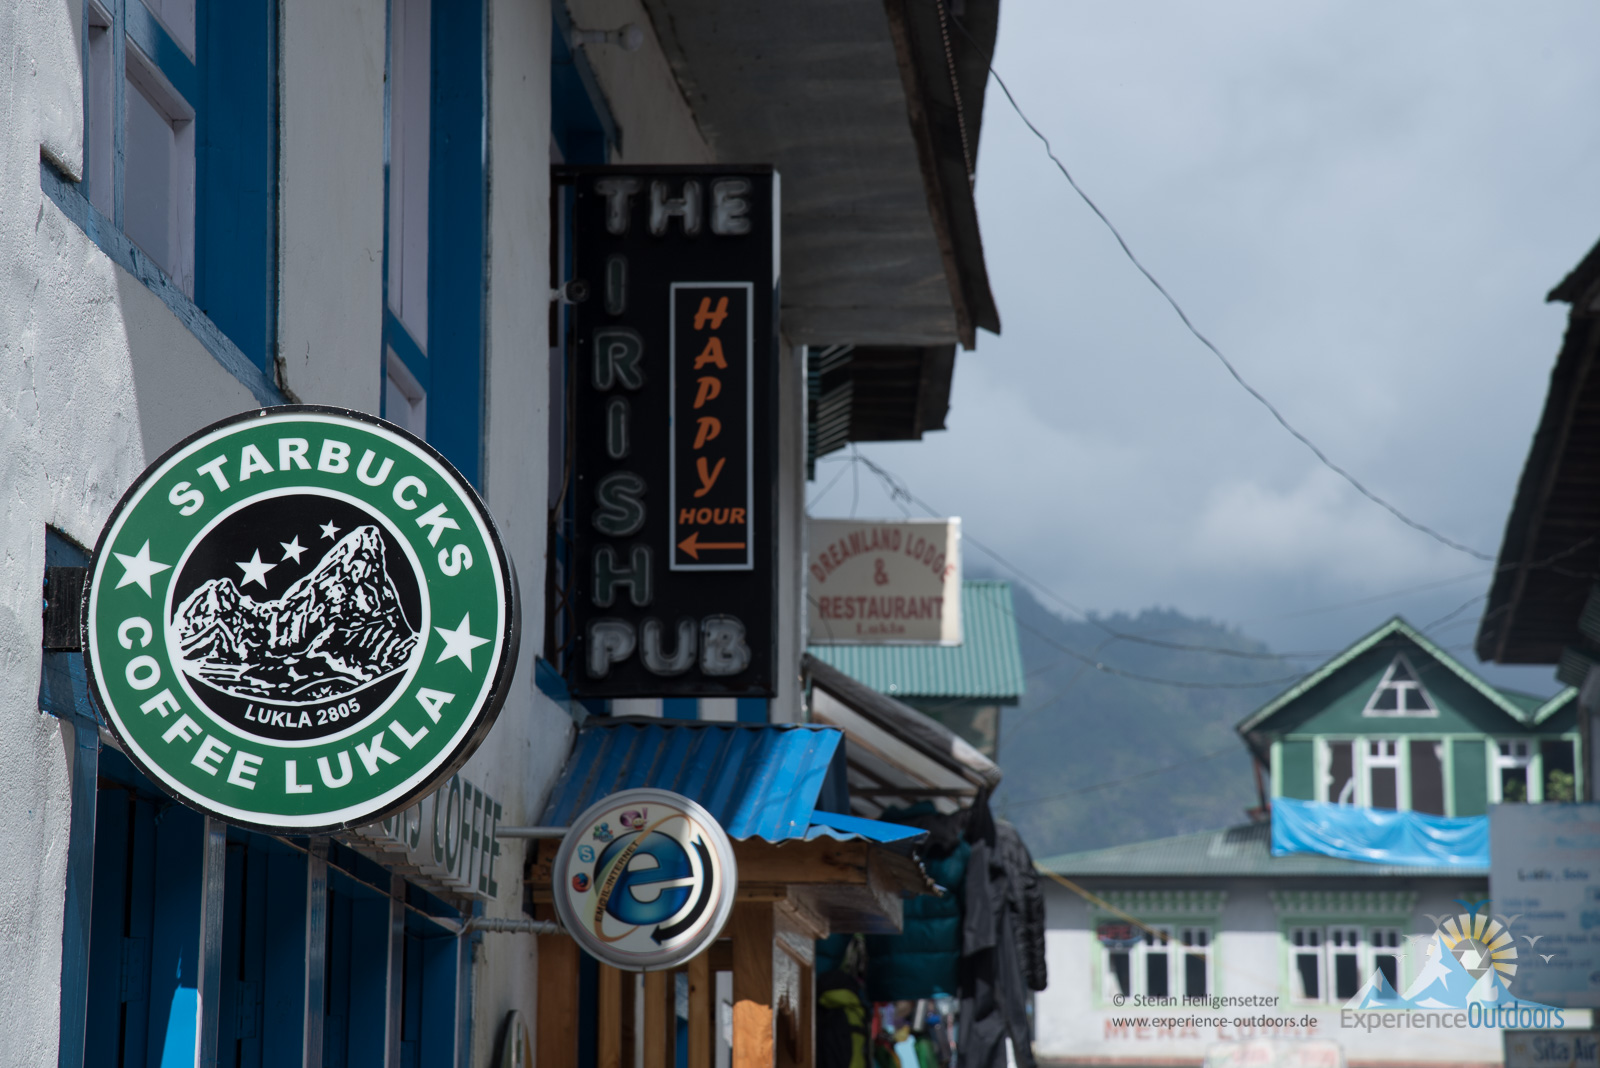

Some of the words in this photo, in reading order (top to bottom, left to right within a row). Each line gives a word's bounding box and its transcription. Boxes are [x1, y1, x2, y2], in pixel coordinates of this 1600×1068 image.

[595, 177, 752, 236] THE
[592, 253, 653, 608] IRISH
[168, 437, 473, 577] STARBUCKS
[678, 507, 746, 525] HOUR
[809, 527, 903, 584] DREAMLAND
[873, 557, 889, 586] &
[818, 596, 944, 620] RESTAURANT
[586, 613, 752, 680] PUB
[117, 616, 264, 790] COFFEE
[284, 686, 456, 795] LUKLA
[244, 703, 313, 728] LUKLA
[316, 697, 361, 726] 2805
[433, 773, 502, 899] COFFEE
